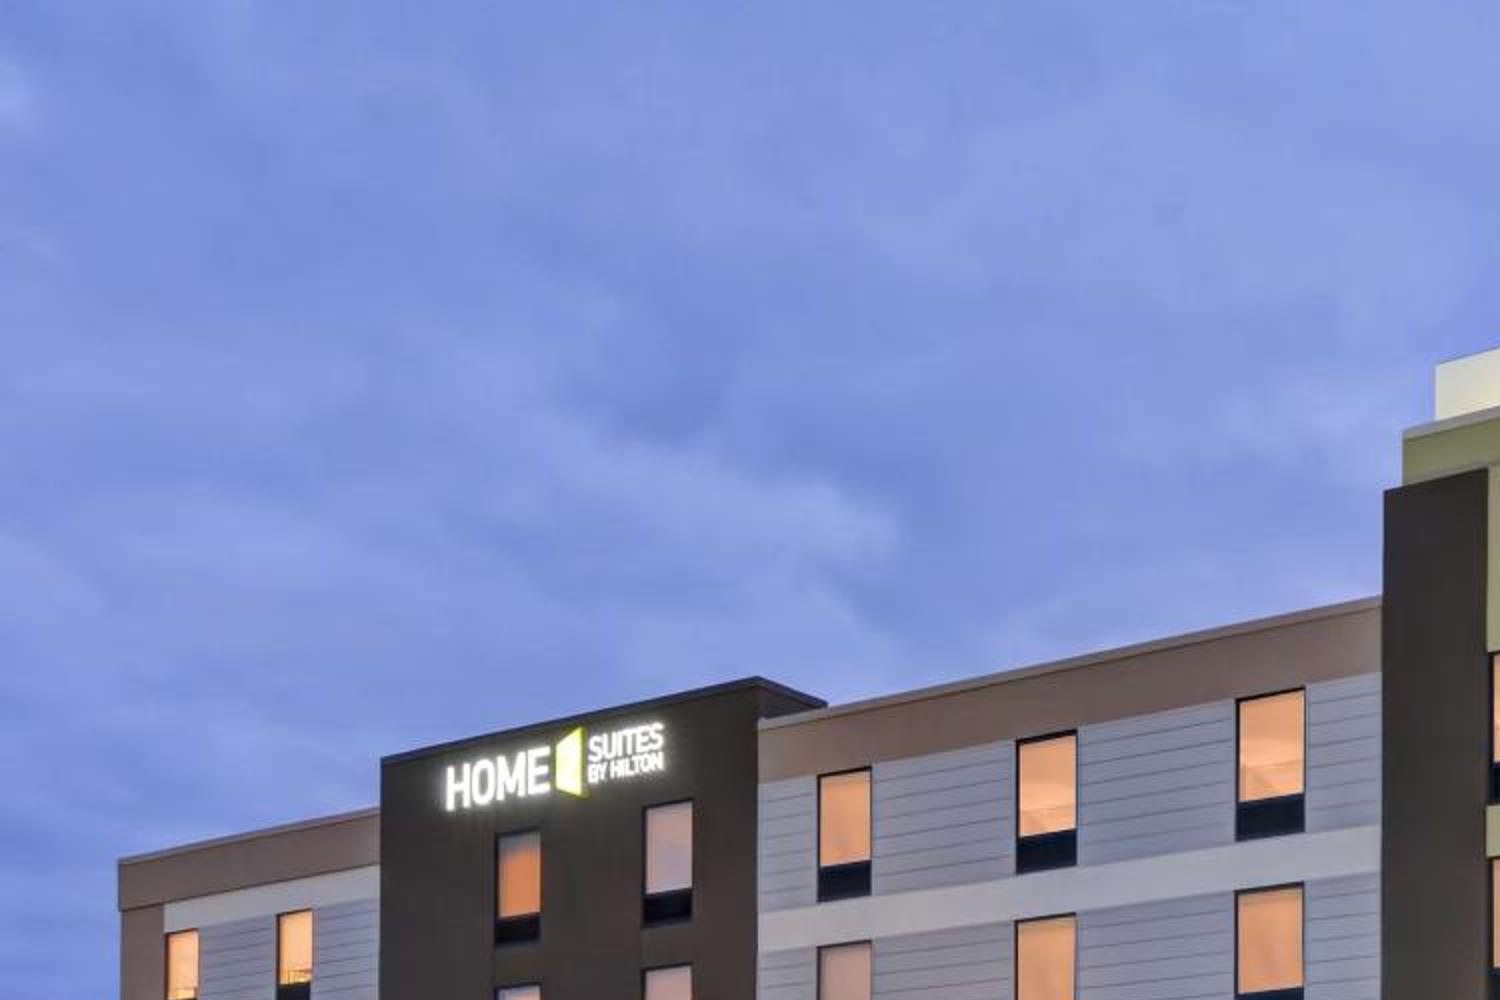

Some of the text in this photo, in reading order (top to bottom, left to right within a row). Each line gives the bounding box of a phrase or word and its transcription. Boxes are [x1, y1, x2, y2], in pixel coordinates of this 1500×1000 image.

[588, 722, 664, 762] SUITES
[446, 745, 551, 811] HOME
[588, 751, 664, 783] BY HILTON
